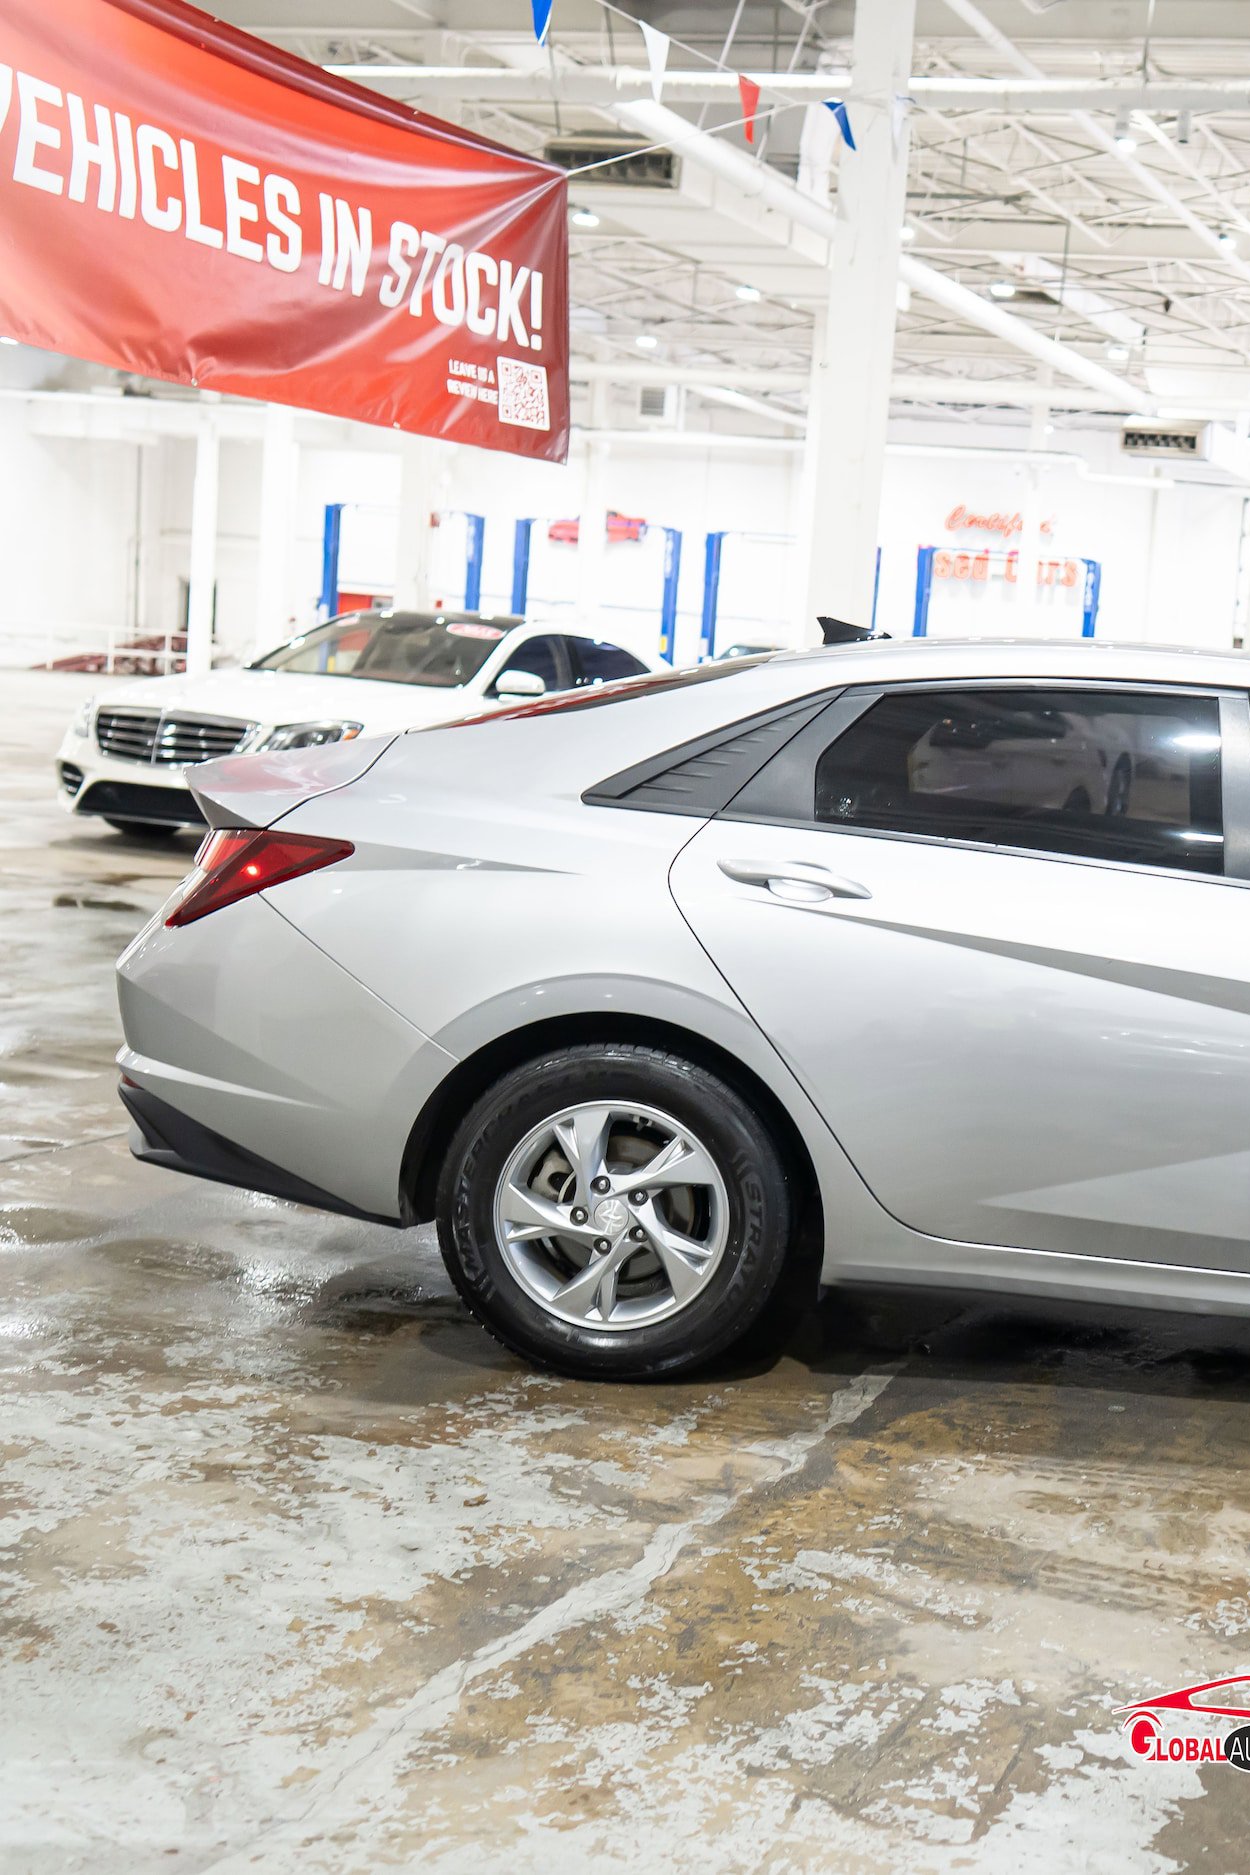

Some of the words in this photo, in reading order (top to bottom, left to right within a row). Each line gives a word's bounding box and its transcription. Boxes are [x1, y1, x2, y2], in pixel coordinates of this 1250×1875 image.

[318, 192, 372, 297] IN
[379, 221, 543, 351] STOCK!
[448, 358, 477, 380] LEAVE
[488, 369, 496, 385] A
[945, 504, 1057, 538] Certifid
[934, 549, 989, 581] sed
